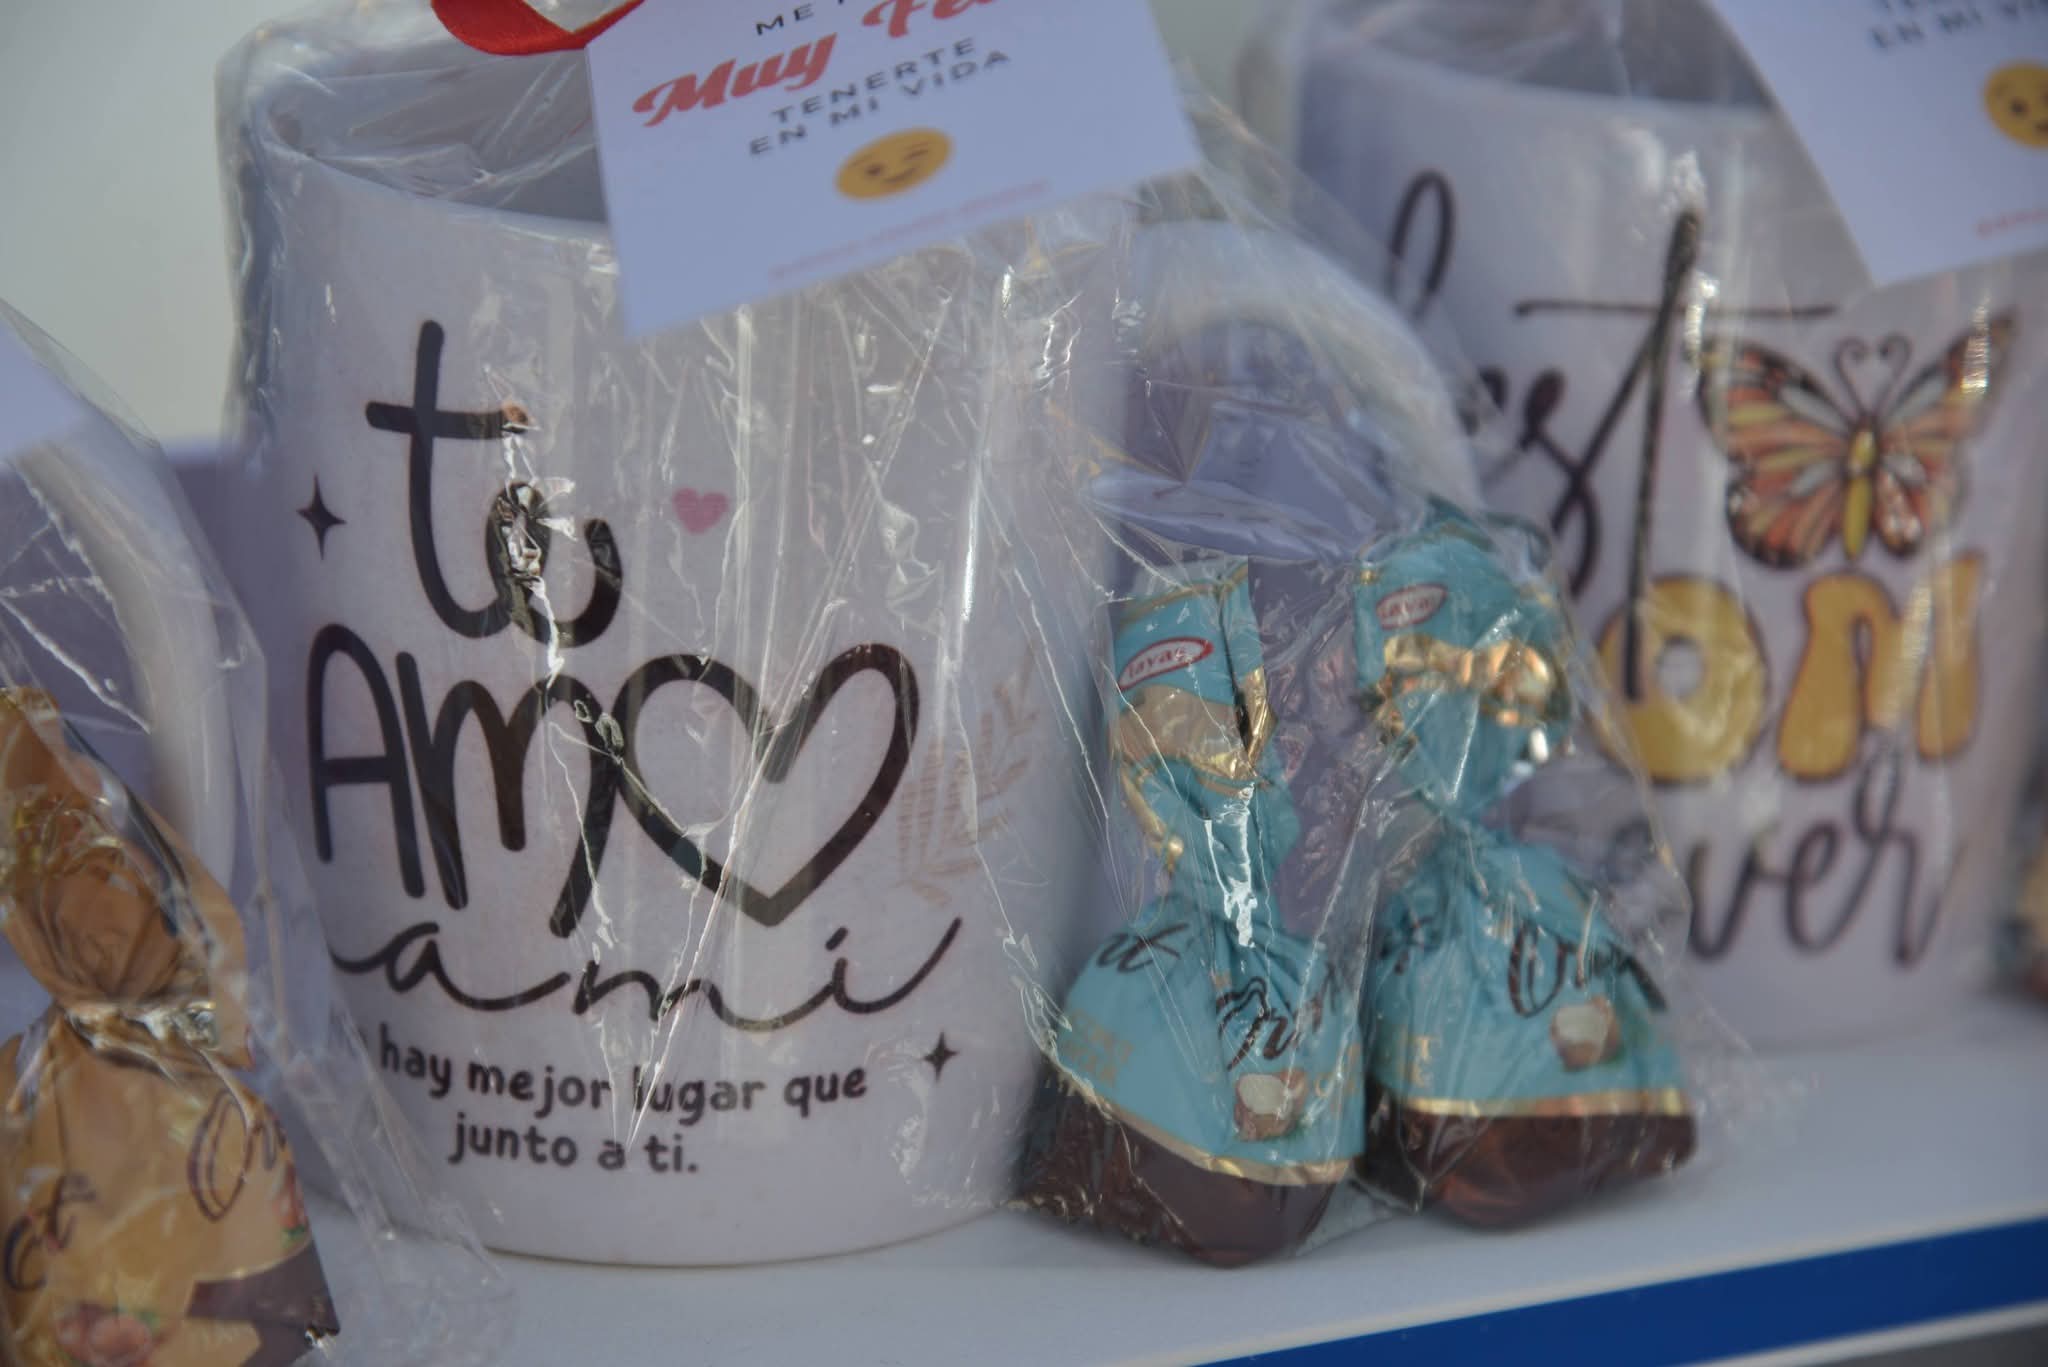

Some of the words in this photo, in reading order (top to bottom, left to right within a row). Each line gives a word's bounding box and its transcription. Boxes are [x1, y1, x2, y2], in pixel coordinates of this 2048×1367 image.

[755, 3, 815, 36] ME
[632, 33, 837, 127] Muy
[748, 124, 808, 156] EN
[828, 96, 880, 127] MI
[902, 49, 1011, 97] VIDA
[771, 37, 977, 124] TENERTE
[379, 1021, 452, 1099] hay
[467, 1065, 613, 1119] mejor
[633, 1065, 766, 1126] lugar
[783, 1067, 868, 1118] que
[448, 1112, 578, 1167] junto
[597, 1139, 627, 1171] a
[643, 1133, 699, 1173] ti.
